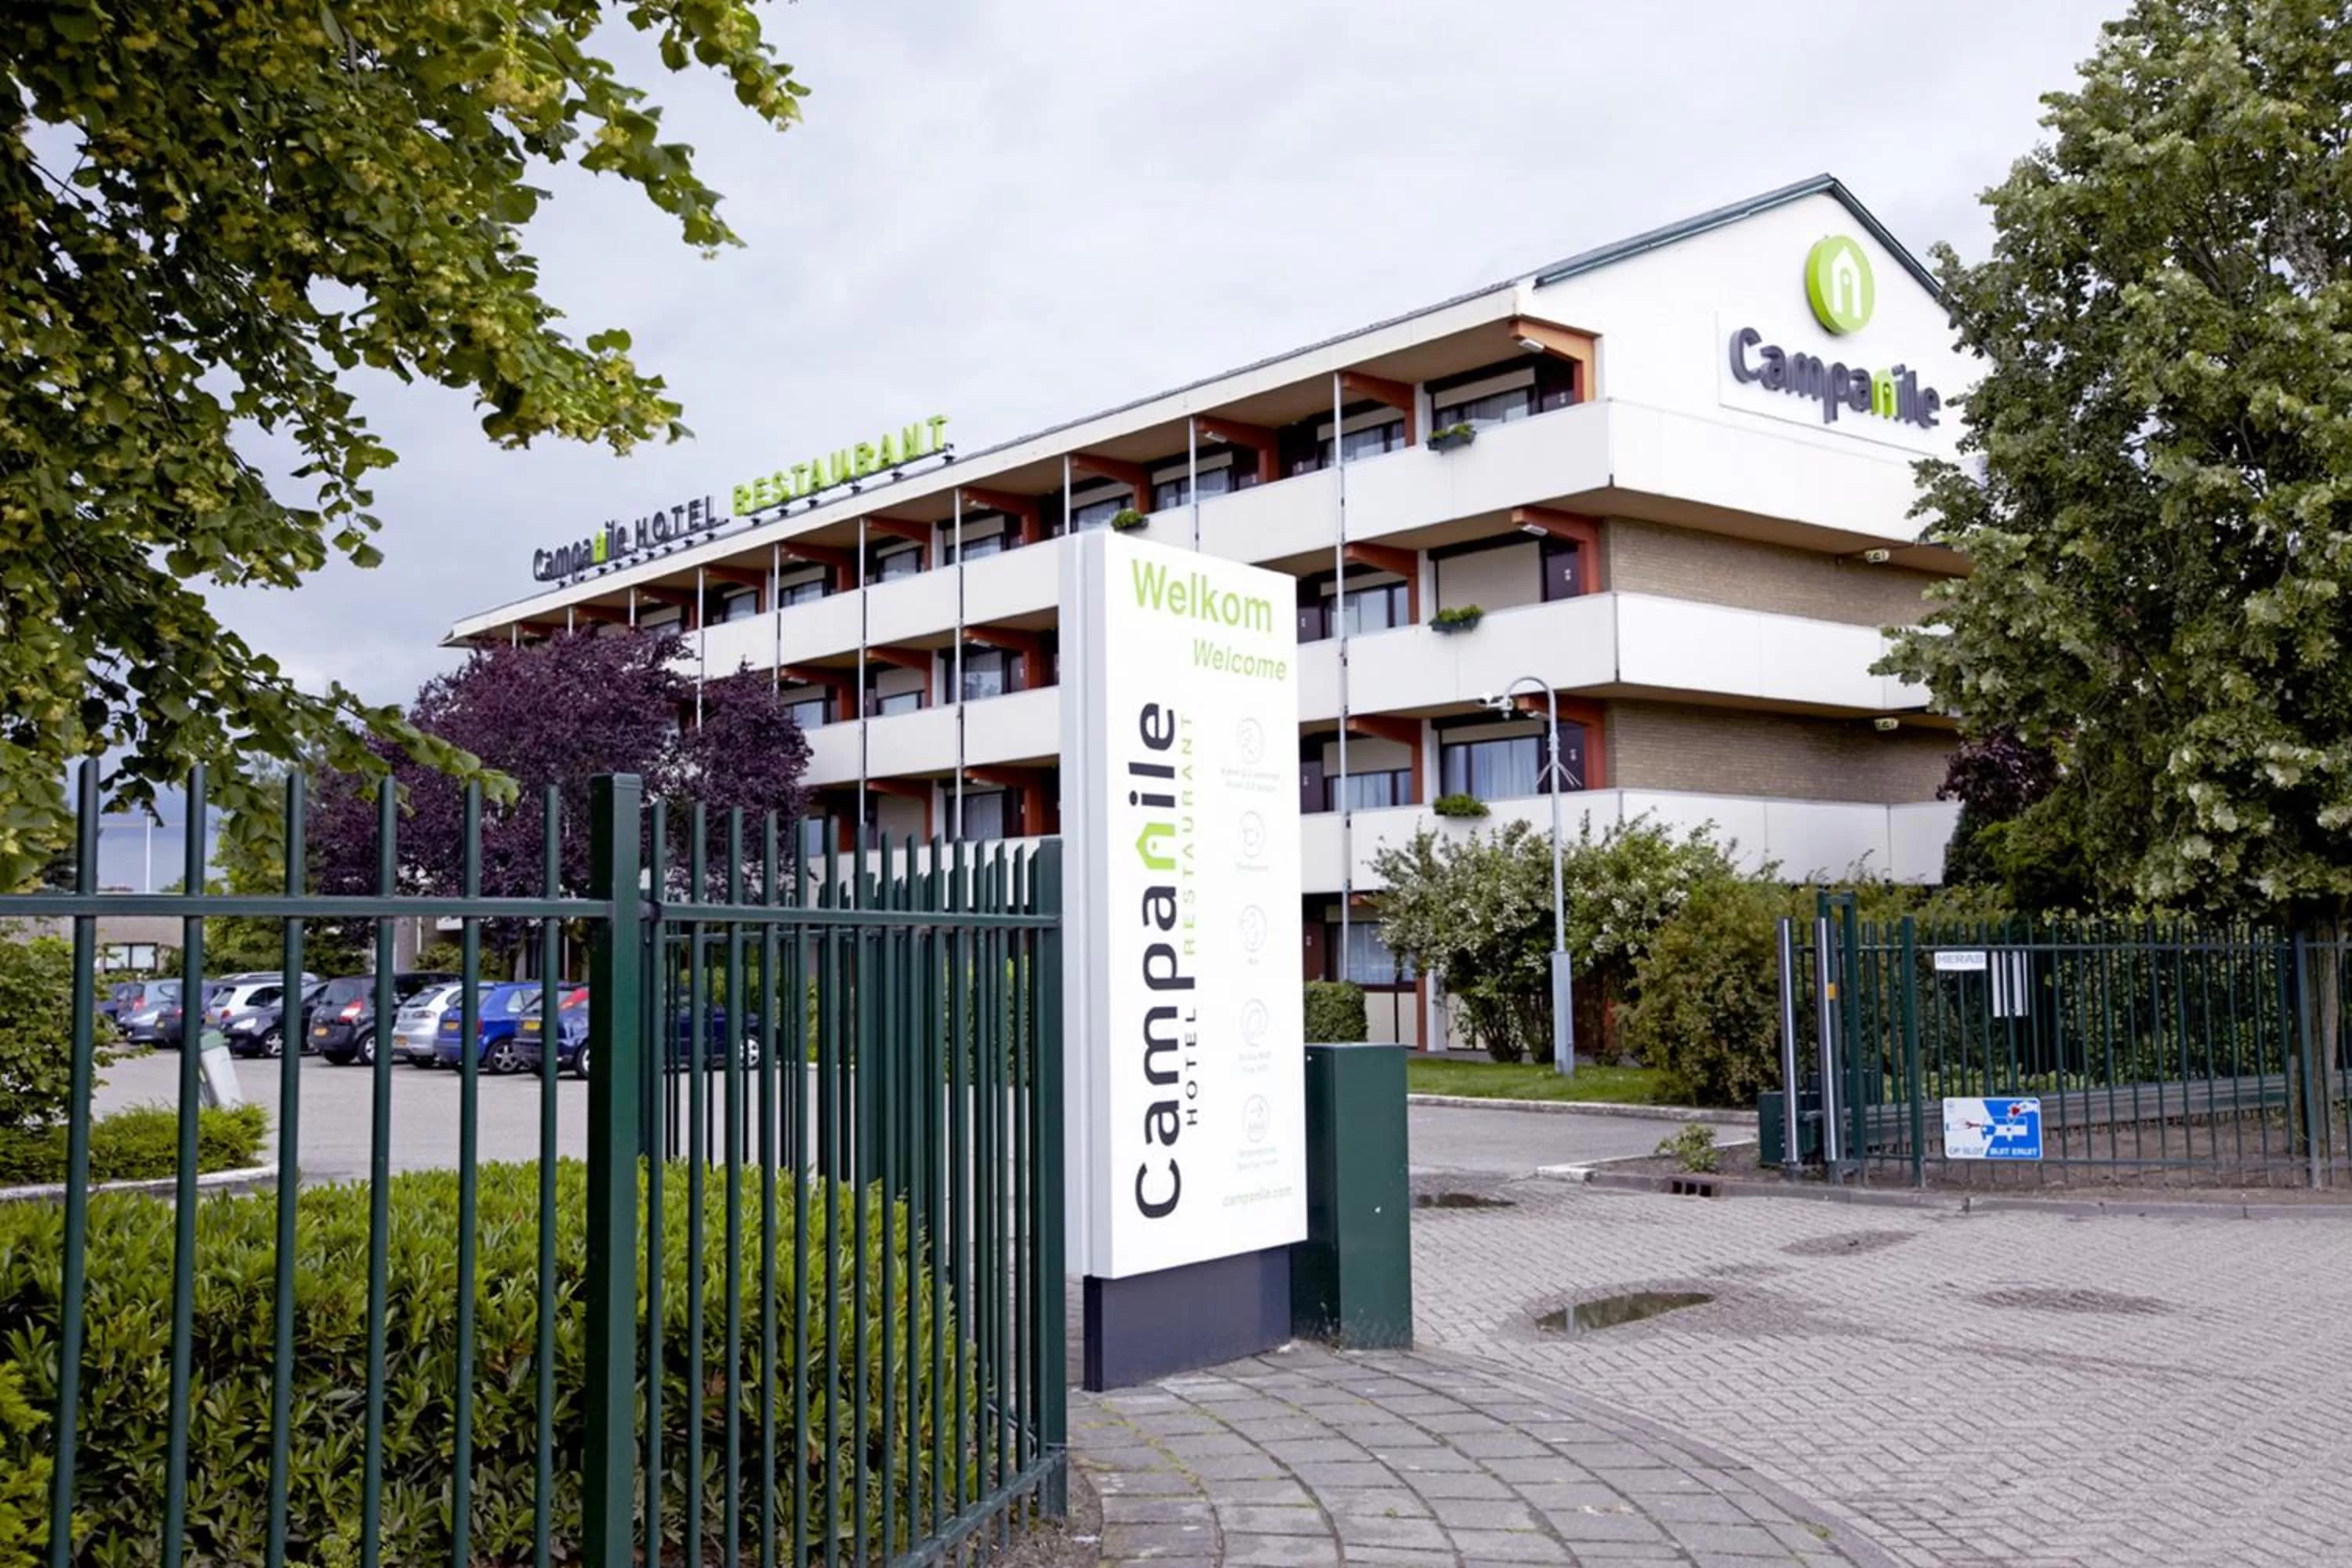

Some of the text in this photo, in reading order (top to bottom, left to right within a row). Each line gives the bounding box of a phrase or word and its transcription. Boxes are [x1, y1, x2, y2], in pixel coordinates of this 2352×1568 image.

[1730, 327, 1940, 430] Campanile
[533, 415, 949, 582] Campanile HOTEL RESTAURANT
[1131, 558, 1272, 632] Welkom
[1193, 638, 1287, 681] Welcome
[1128, 702, 1196, 1219] Campanile
[1180, 714, 1198, 1127] HOTEL RESTAURANT
[1936, 953, 1985, 966] HERAS
